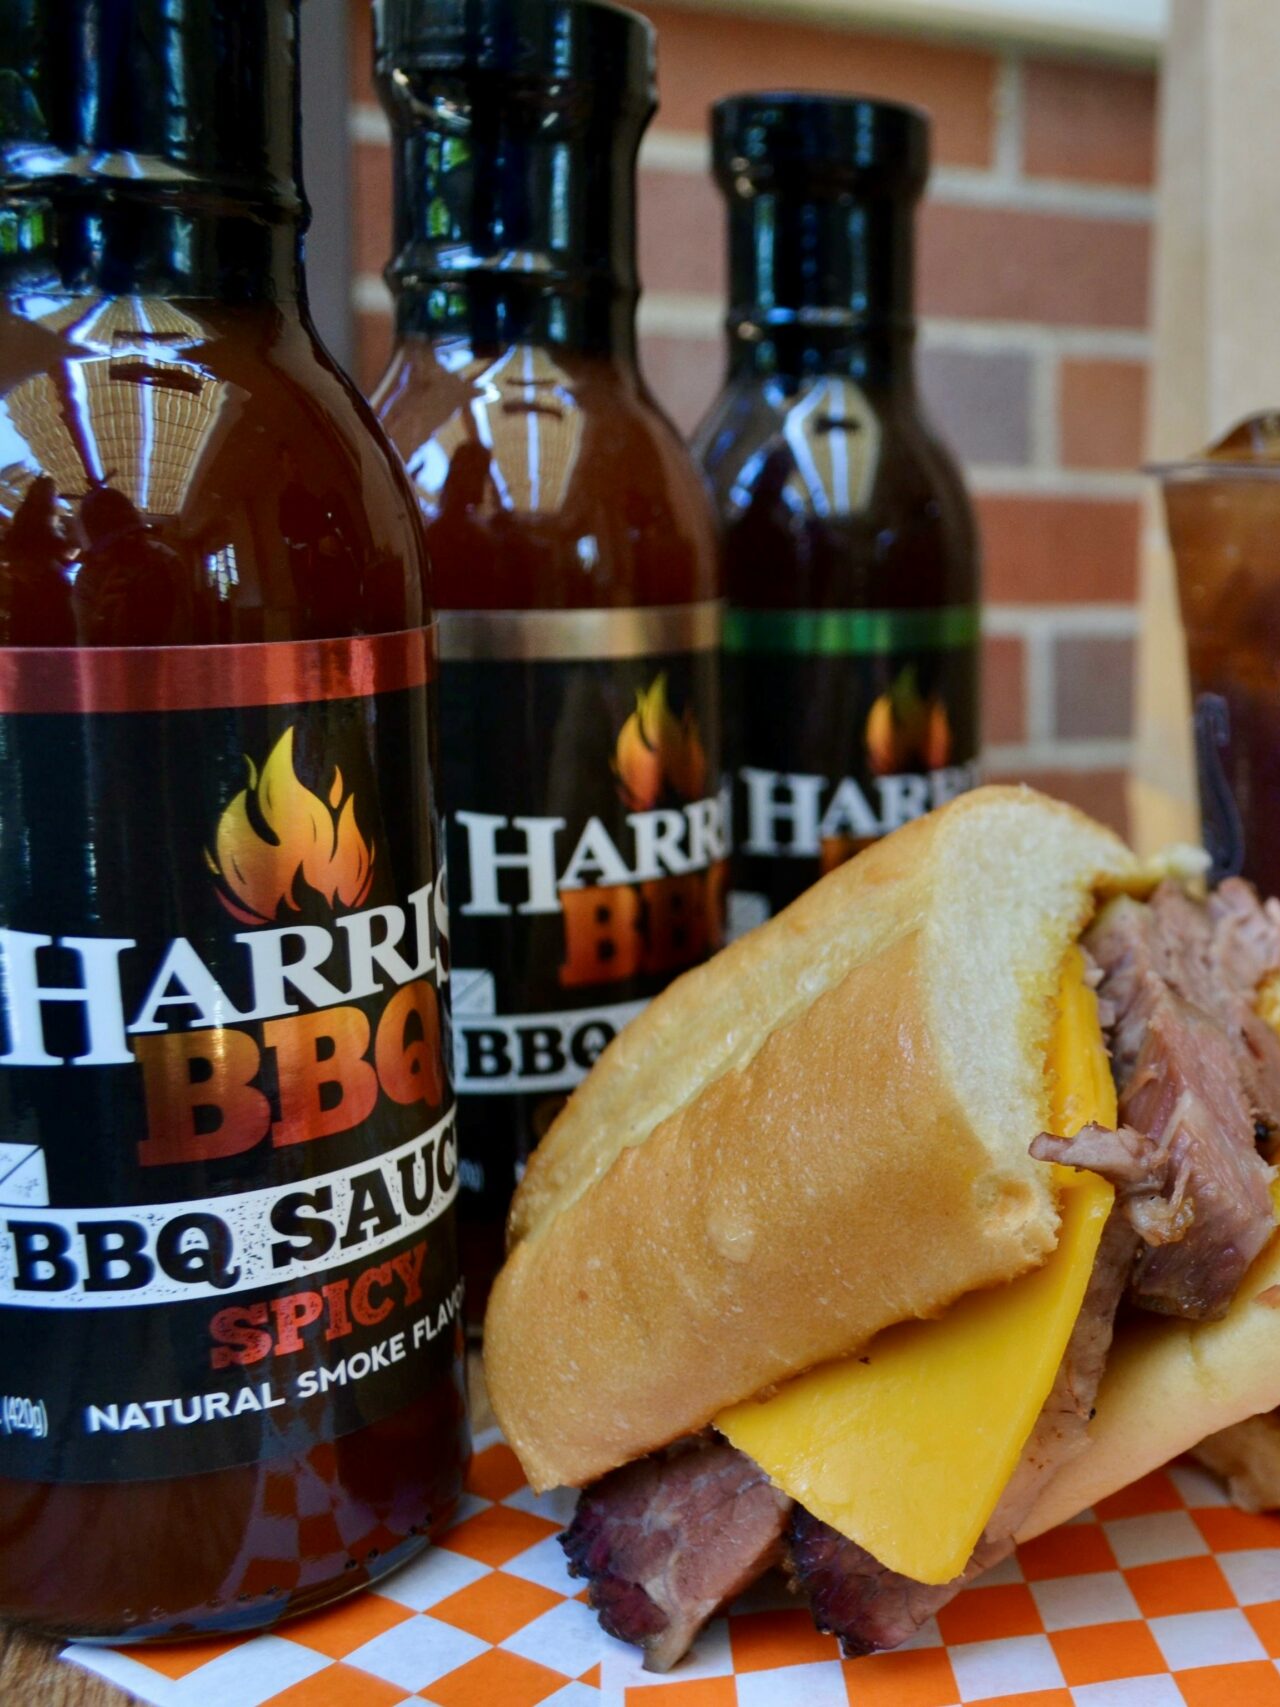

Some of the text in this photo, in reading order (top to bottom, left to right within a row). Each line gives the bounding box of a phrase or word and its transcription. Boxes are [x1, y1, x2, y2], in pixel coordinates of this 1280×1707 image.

[134, 979, 444, 1167] BBQ
[461, 1018, 616, 1080] BBQ
[6, 1120, 457, 1290] BBQ SAUC
[209, 1240, 429, 1369] SPICY
[86, 1381, 286, 1433] NATURAL
[297, 1332, 406, 1399] SMOKE
